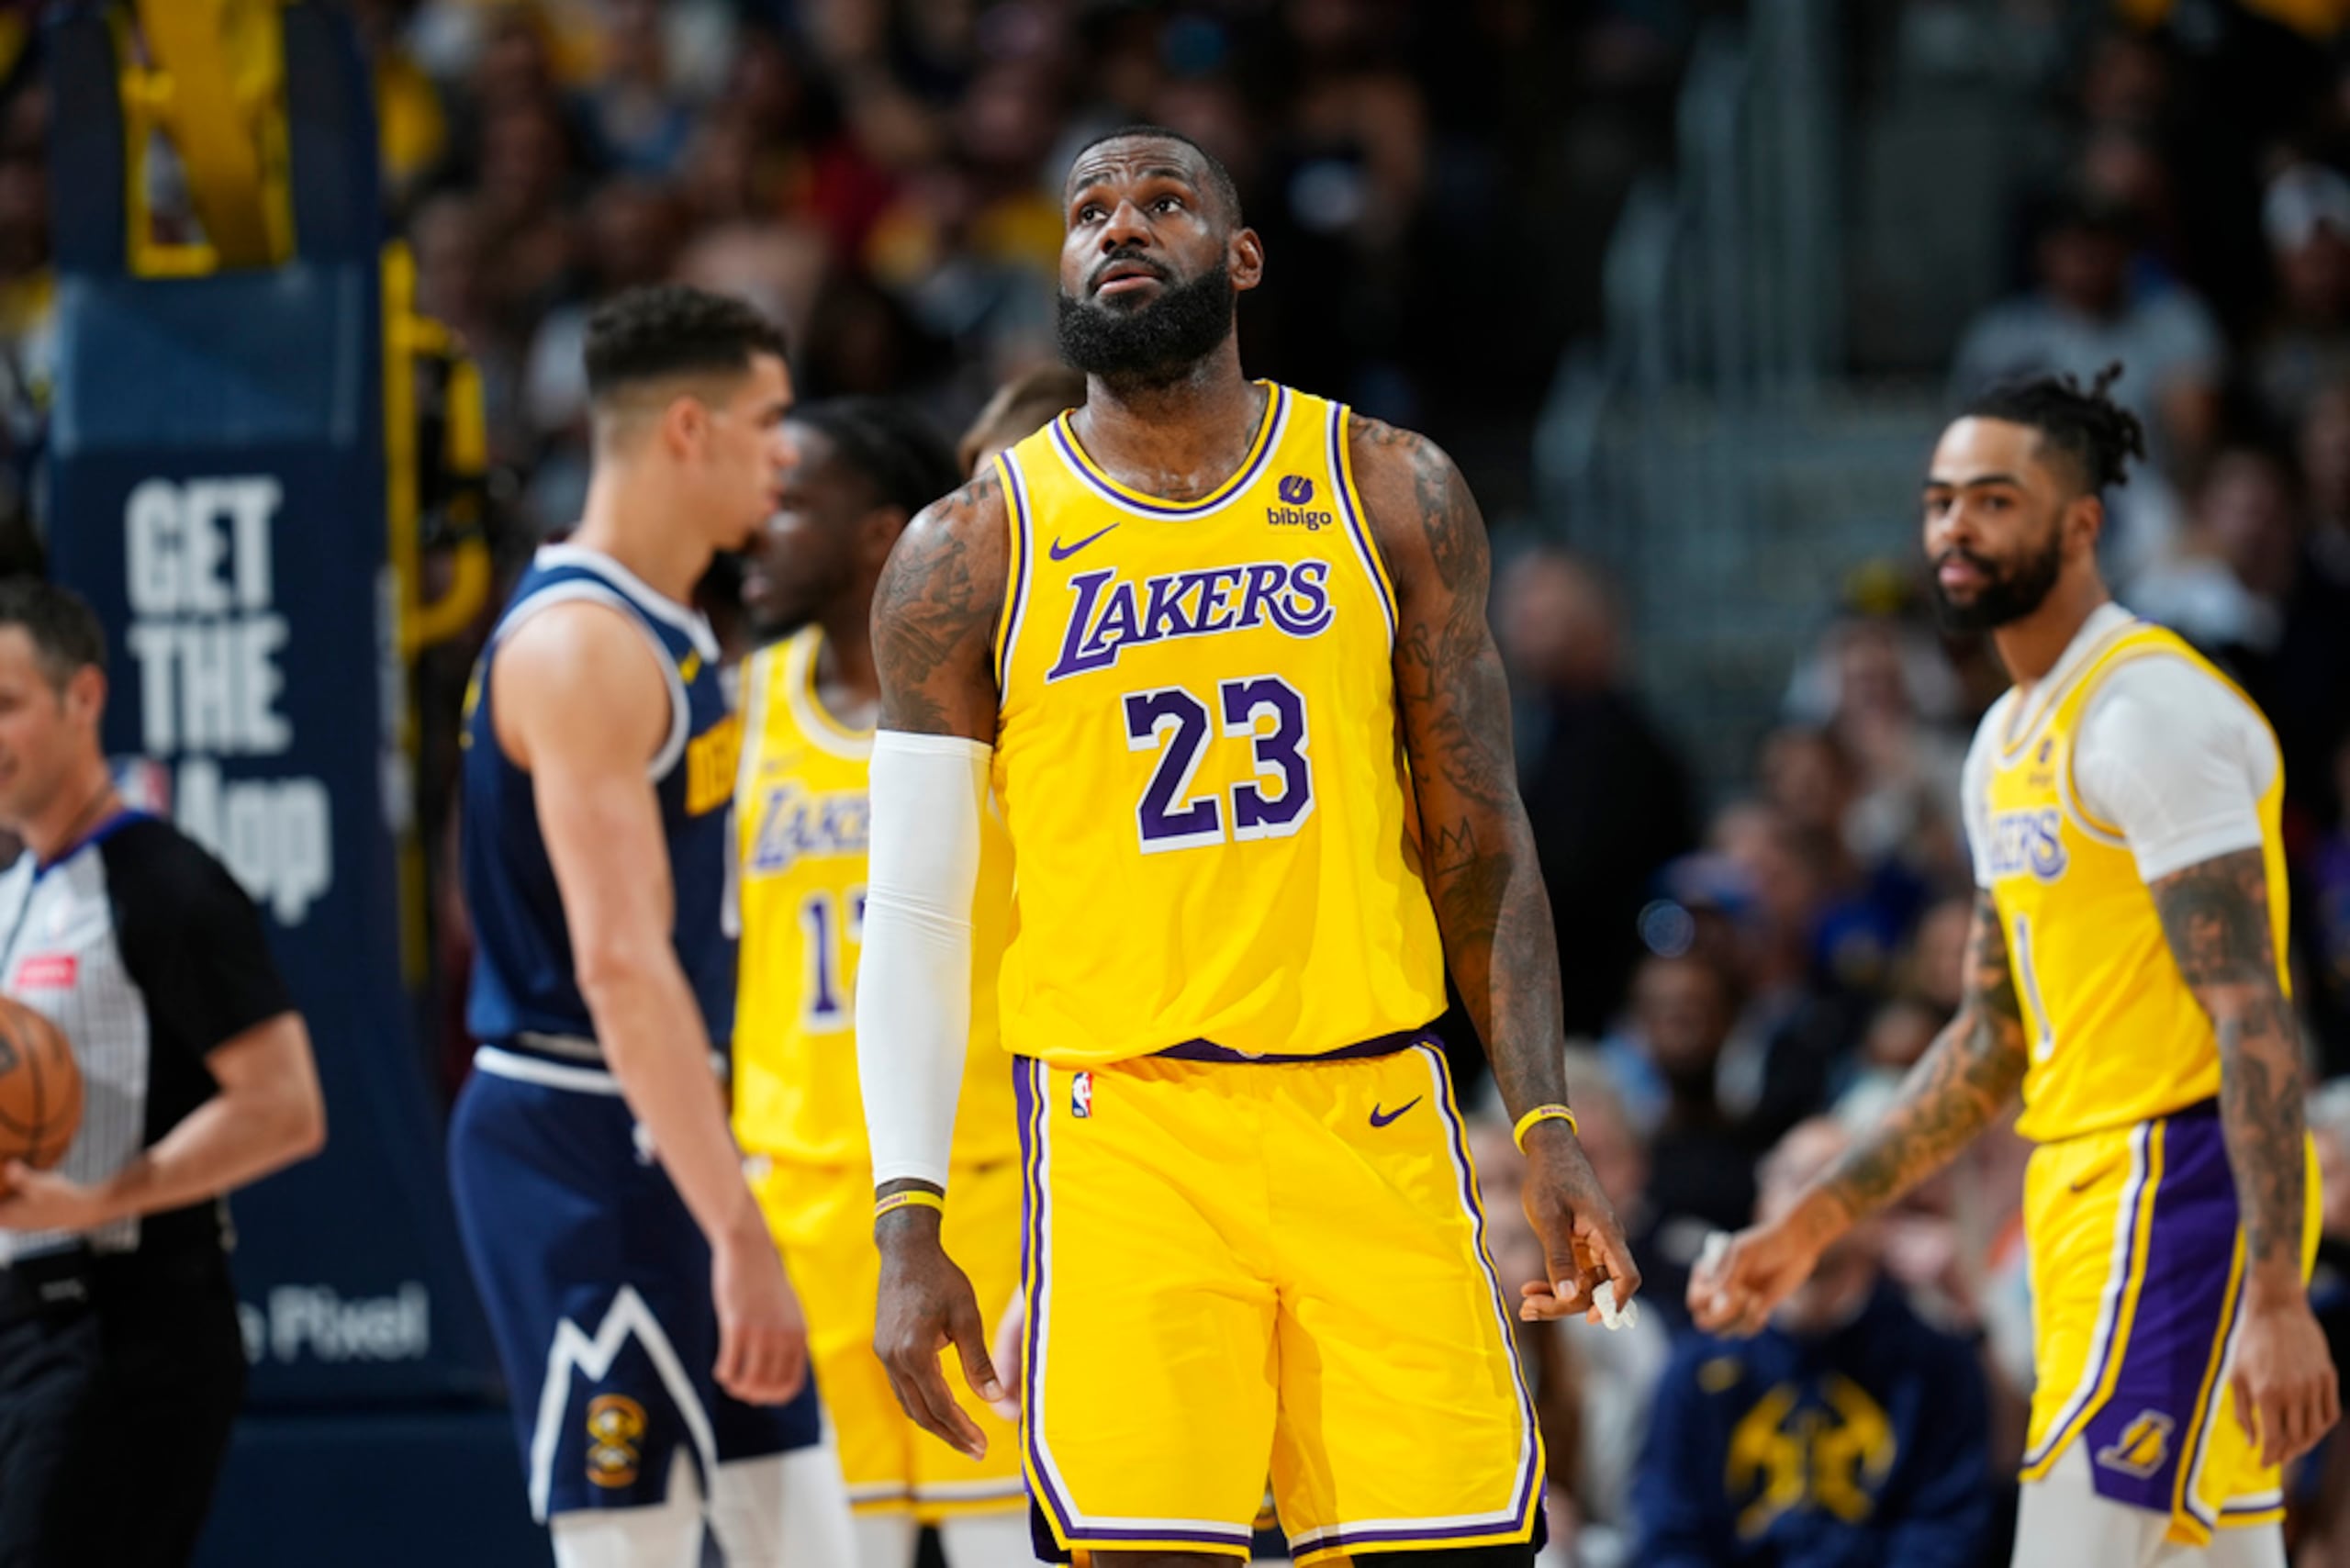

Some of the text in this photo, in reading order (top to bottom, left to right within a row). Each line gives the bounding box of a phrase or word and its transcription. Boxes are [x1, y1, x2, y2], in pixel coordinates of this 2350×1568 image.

[126, 475, 282, 615] GET
[1266, 507, 1333, 531] bibigo
[126, 616, 292, 756] THE
[1045, 558, 1336, 685] LAKERS
[1121, 673, 1315, 856] 23
[174, 758, 331, 926] App
[800, 884, 867, 1034] 1
[269, 1282, 428, 1365] Pixel
